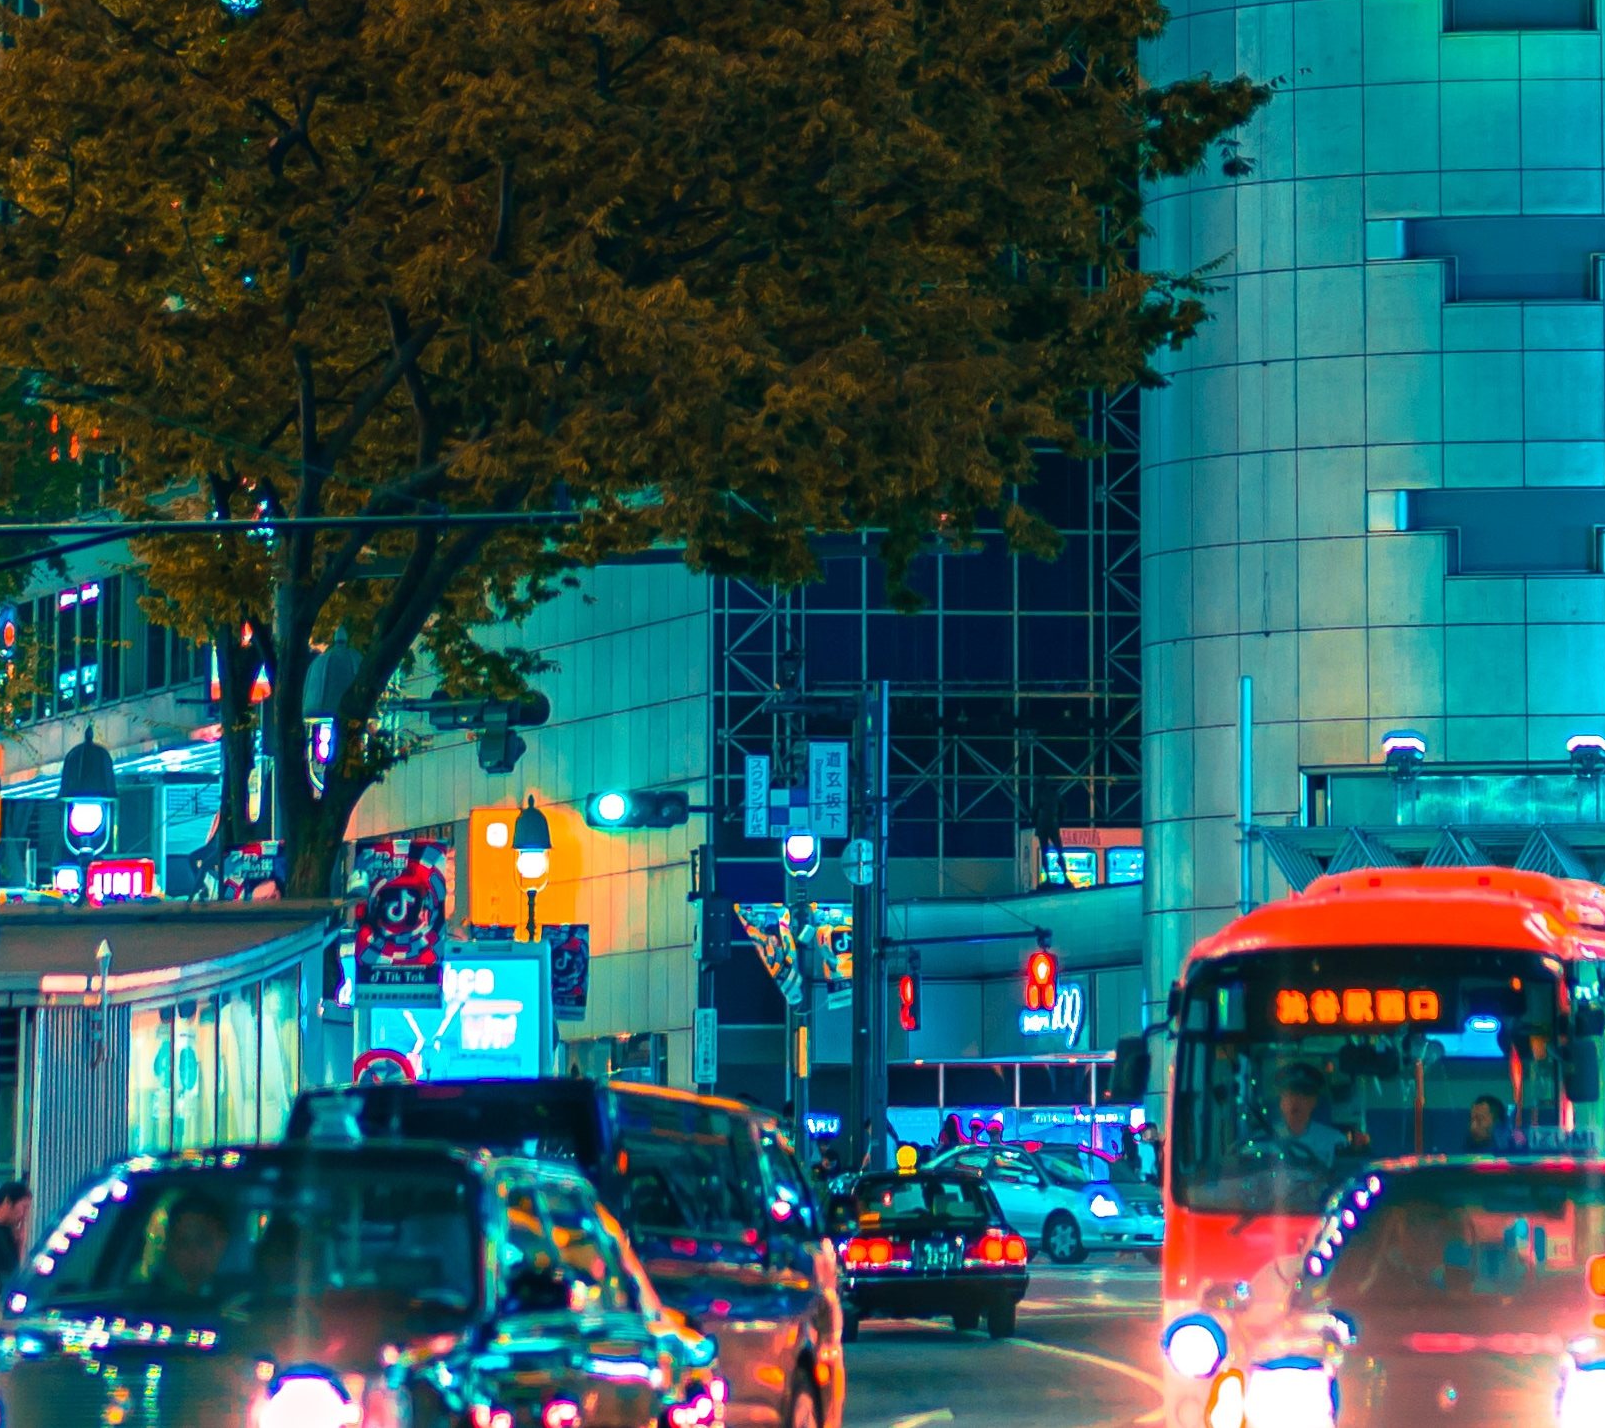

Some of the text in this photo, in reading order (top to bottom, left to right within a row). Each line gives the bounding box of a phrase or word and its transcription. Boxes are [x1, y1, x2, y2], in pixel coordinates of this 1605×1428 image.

[749, 758, 765, 836] スクランブル式
[824, 748, 843, 830] 道玄坂下
